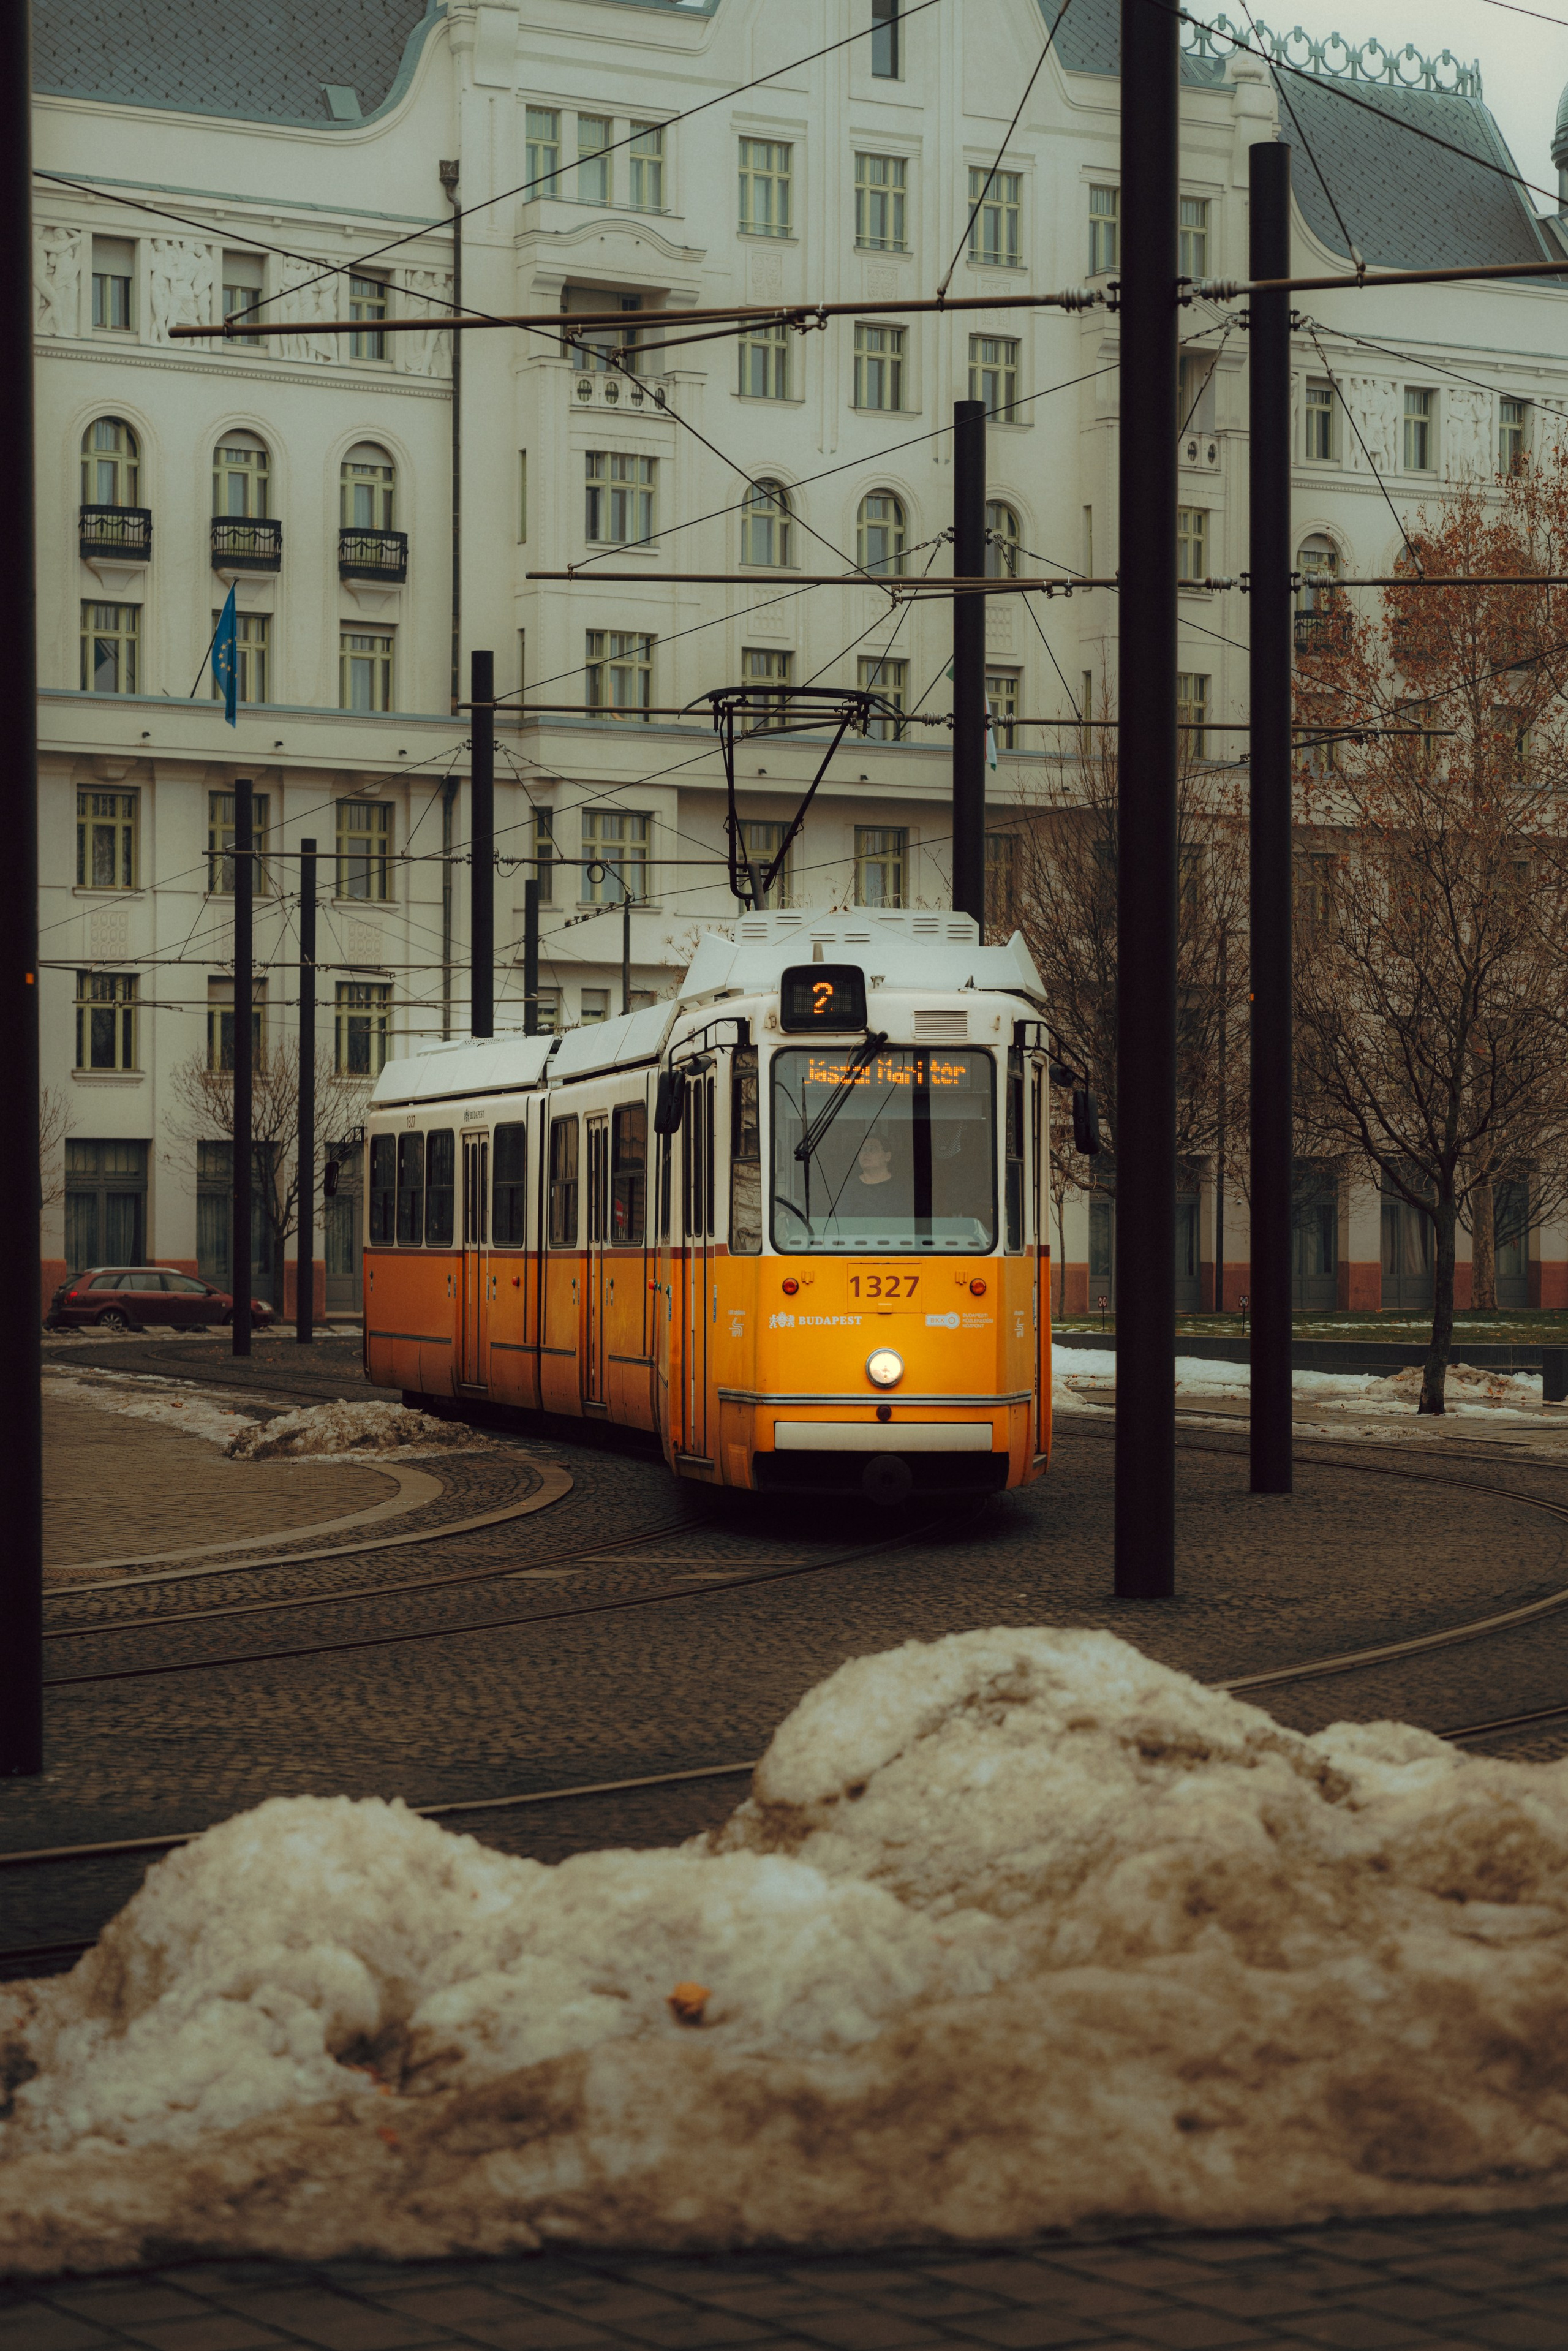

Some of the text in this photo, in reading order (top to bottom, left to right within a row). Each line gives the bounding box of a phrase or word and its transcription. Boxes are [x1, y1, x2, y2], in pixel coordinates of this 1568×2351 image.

[813, 983, 833, 1013] 2
[878, 1059, 922, 1084] Mari
[407, 1115, 416, 1128] 1327
[470, 1110, 484, 1119] BUDAPEST
[849, 1275, 919, 1297] 1327
[798, 1316, 862, 1325] BUDAPEST
